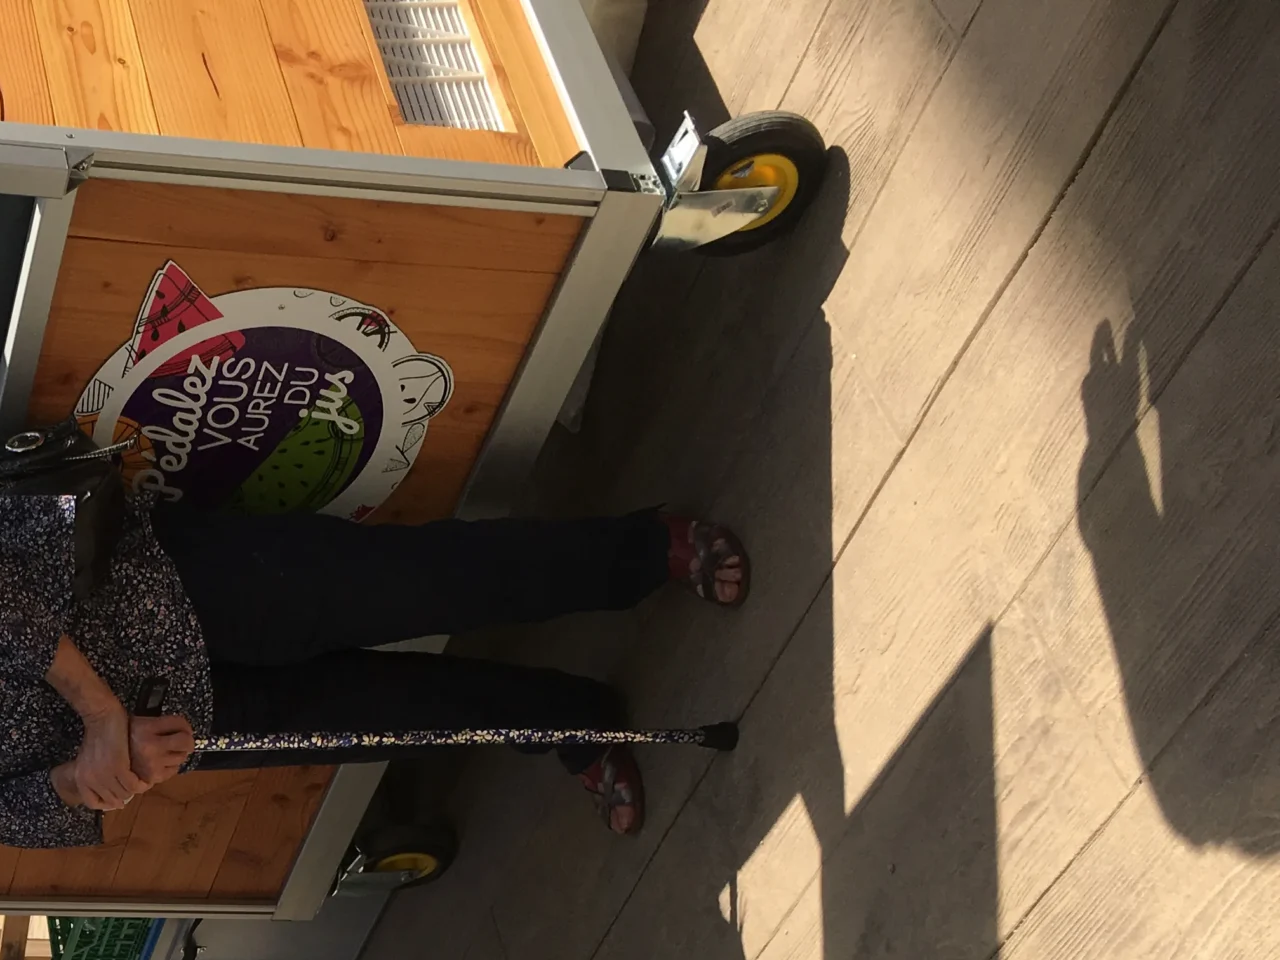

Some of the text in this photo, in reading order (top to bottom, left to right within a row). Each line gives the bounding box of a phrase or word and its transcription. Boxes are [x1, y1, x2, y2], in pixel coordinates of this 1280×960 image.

[132, 354, 220, 502] Pédalez
[197, 357, 256, 451] VOUS
[237, 362, 289, 451] AUREZ
[283, 366, 320, 405] DU
[298, 370, 360, 435] jus
